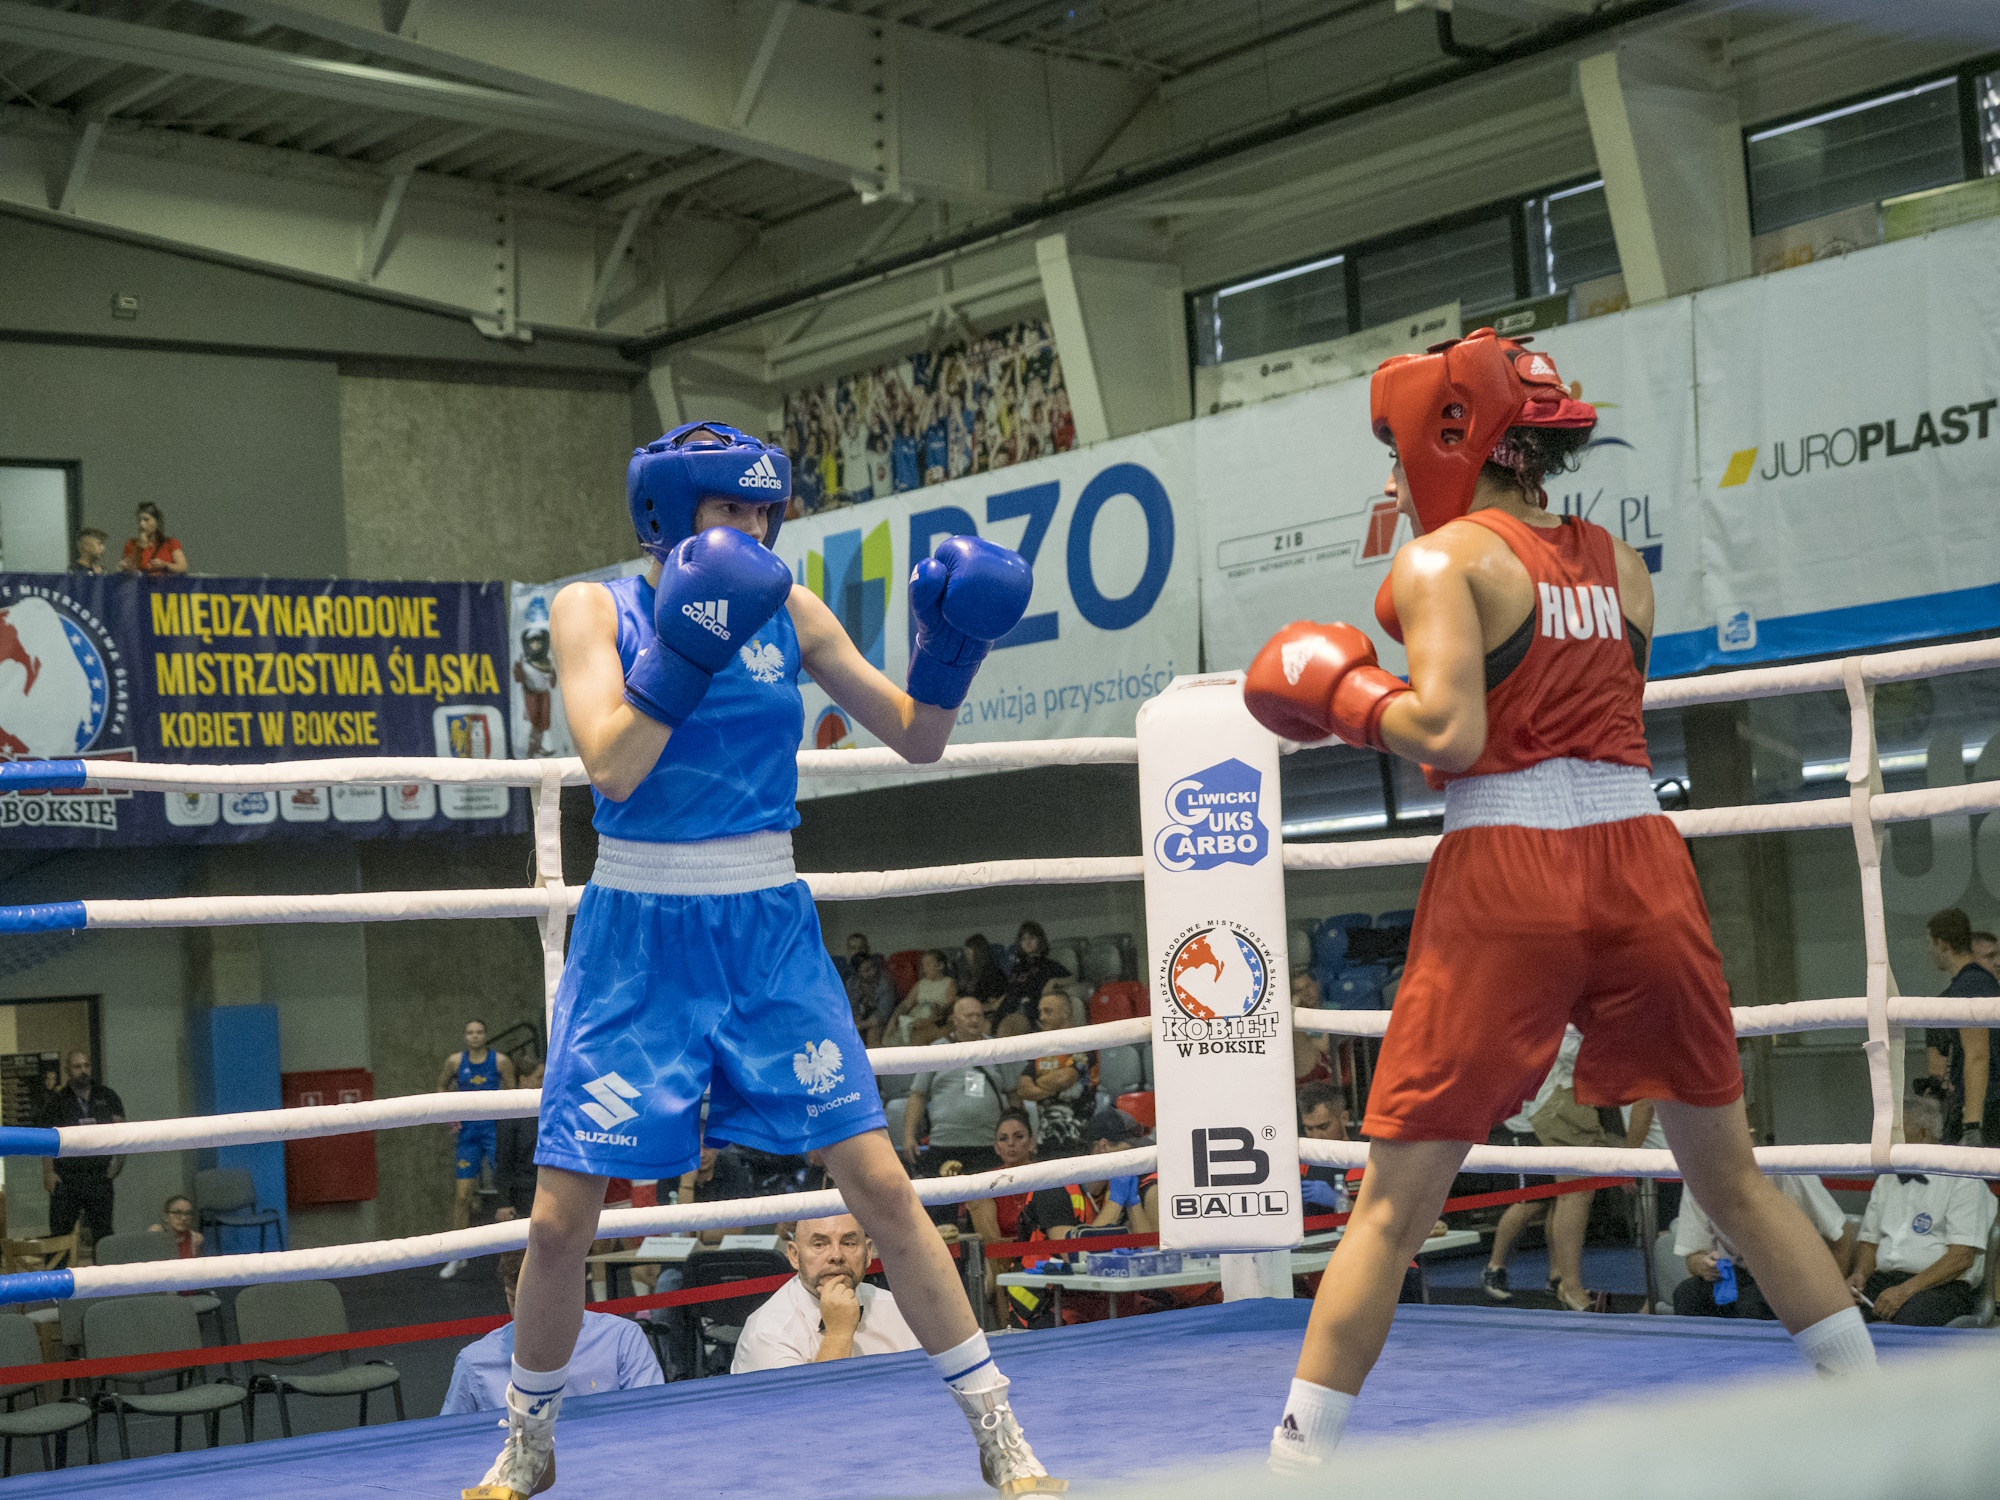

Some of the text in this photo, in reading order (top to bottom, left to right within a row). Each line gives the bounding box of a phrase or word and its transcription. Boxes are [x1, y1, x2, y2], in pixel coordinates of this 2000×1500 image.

[1761, 398, 1998, 481] JUROPLAST
[738, 475, 782, 490] adidas
[1274, 531, 1304, 551] ZIB
[150, 592, 441, 645] MIĘDZYNARODOWE
[681, 603, 732, 642] adidas
[1537, 581, 1623, 641] HUN
[155, 645, 500, 703] MISTRZOSTWA ŚLĄSKA
[979, 685, 1037, 724] wizja
[1043, 660, 1174, 720] przyszłości
[159, 710, 380, 748] KOBIET W BOKSIE
[1, 800, 114, 826] BOKSIE
[1166, 779, 1257, 826] GLIWICKI
[1208, 810, 1254, 833] UKS
[1155, 824, 1258, 872] CARBO
[1207, 919, 1274, 965] MISTRZOSTWA
[1162, 1011, 1280, 1042] KOBIET
[1177, 1039, 1266, 1058] W BOKSIE
[817, 1091, 861, 1114] brachole
[574, 1129, 638, 1147] SUZUKI
[1175, 1194, 1283, 1217] BAIL
